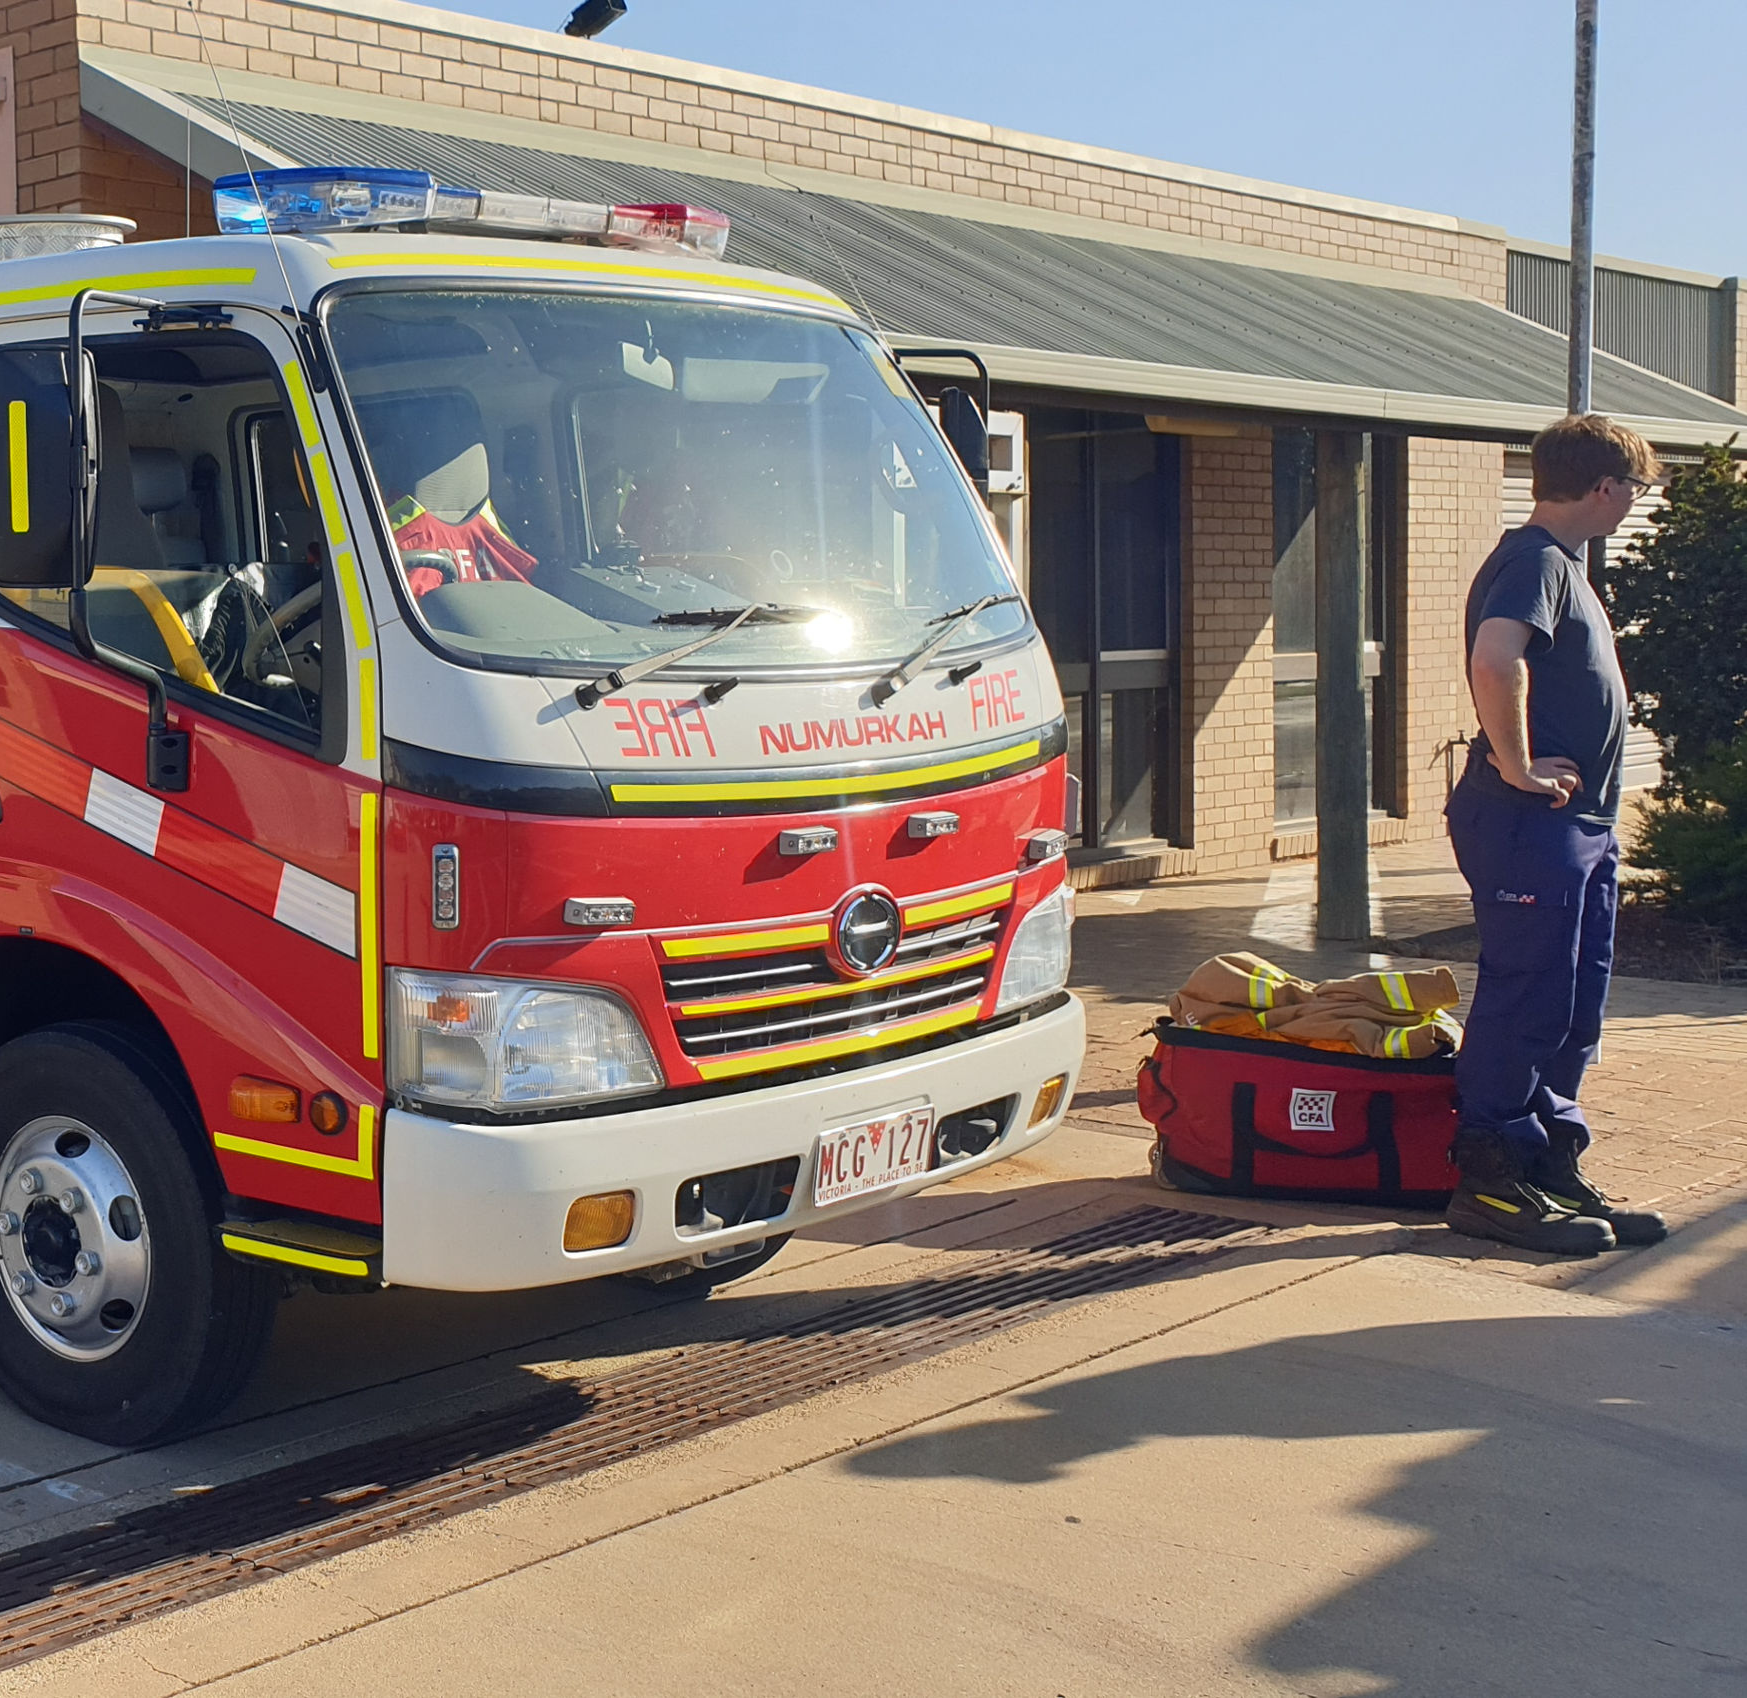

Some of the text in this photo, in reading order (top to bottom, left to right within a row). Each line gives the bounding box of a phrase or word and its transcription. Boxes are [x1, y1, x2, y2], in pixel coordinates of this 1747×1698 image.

[968, 669, 1025, 732] FIRE
[759, 710, 947, 755] NUMURKAH
[1298, 1112, 1324, 1123] CFA
[819, 1118, 929, 1188] MCG 127
[818, 1183, 852, 1201] VICTORIA
[862, 1176, 875, 1188] THE
[878, 1169, 900, 1184] PLACE
[902, 1165, 912, 1177] TO
